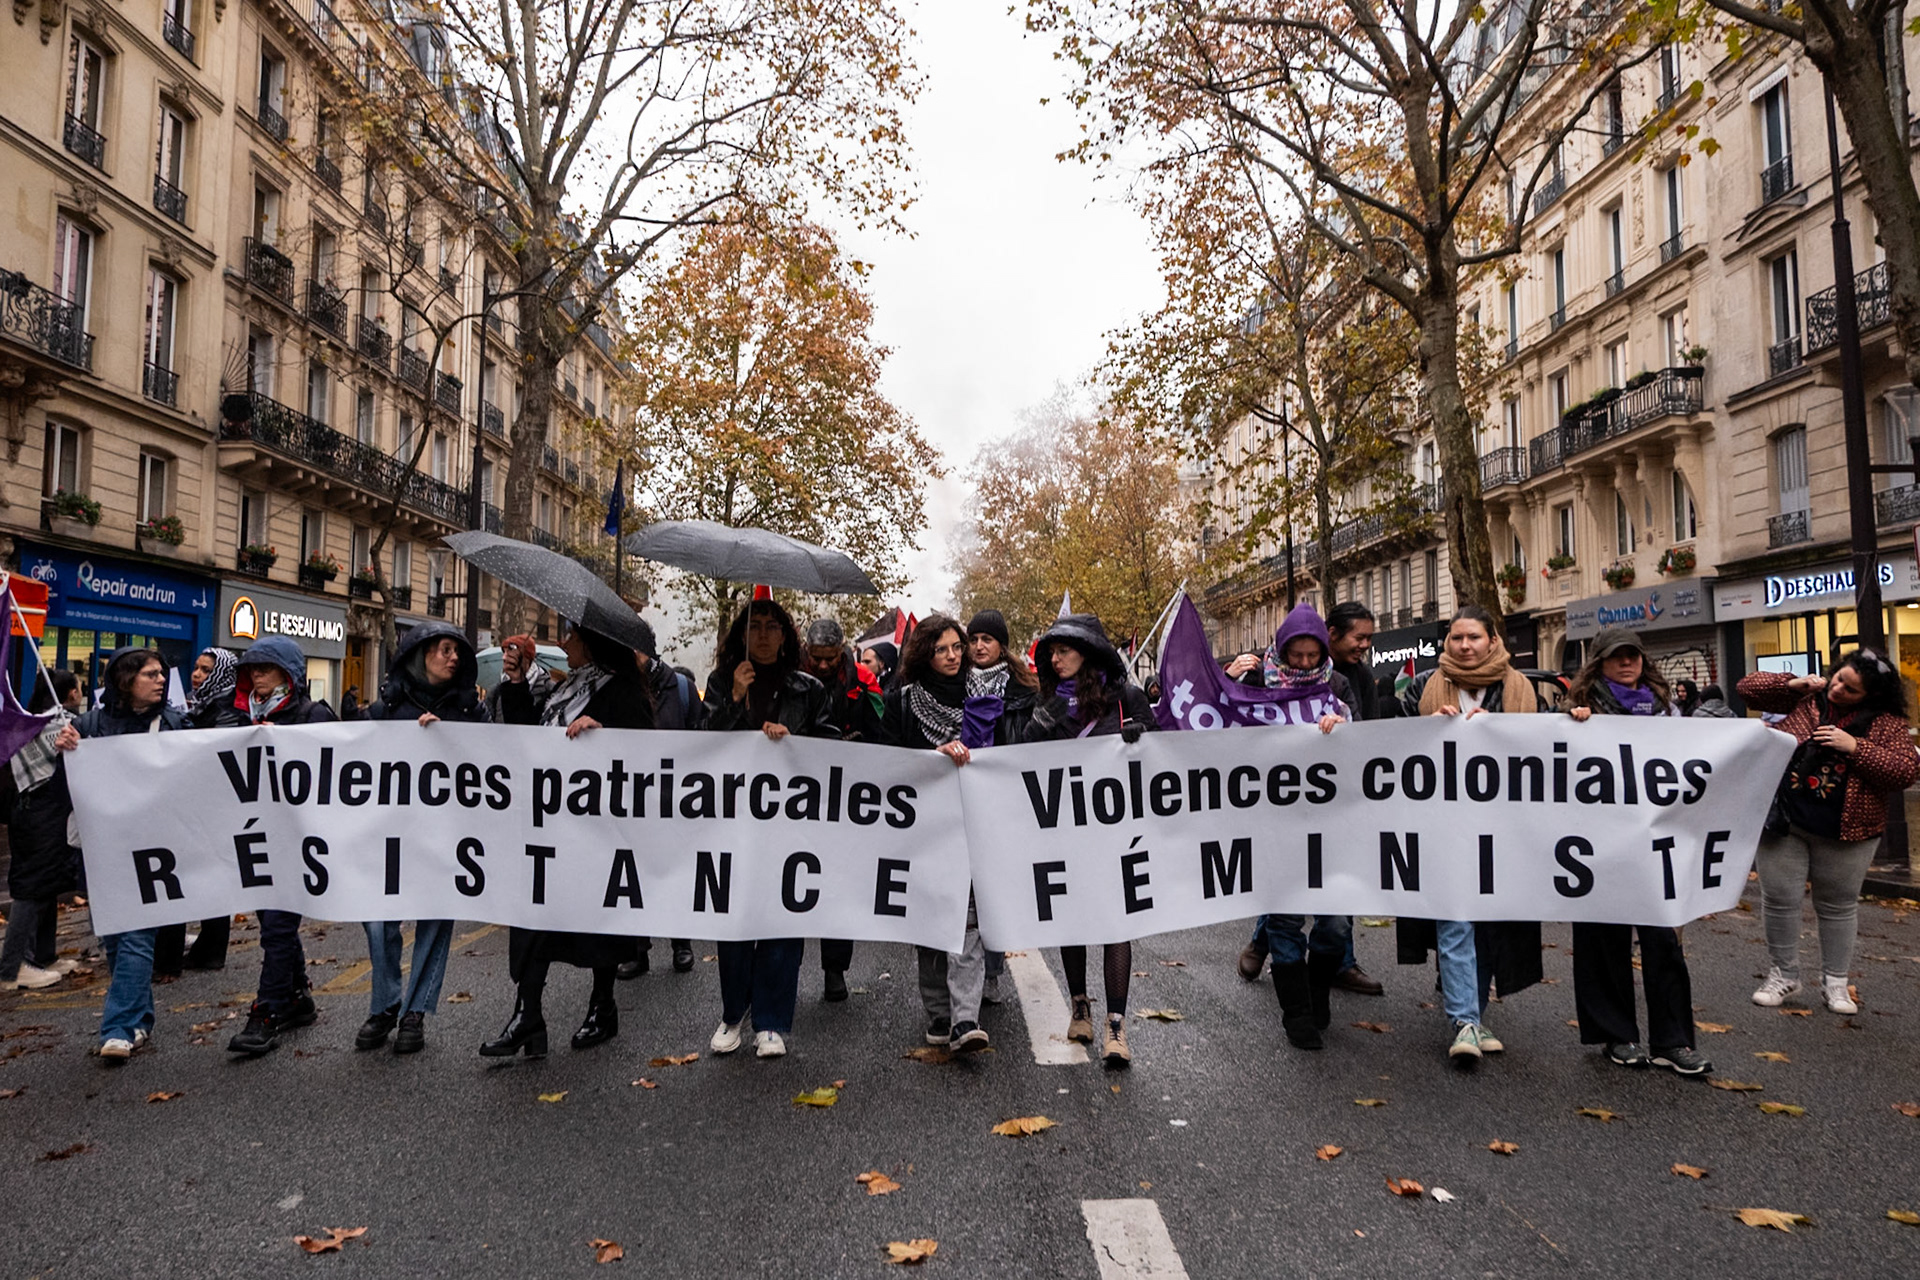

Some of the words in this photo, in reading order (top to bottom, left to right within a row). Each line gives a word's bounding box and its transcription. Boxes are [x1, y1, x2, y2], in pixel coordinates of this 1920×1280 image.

[77, 561, 128, 597] Repair
[129, 584, 155, 601] and
[156, 588, 176, 604] run
[1785, 564, 1893, 598] DESCHAUS
[264, 610, 278, 633] LE
[280, 612, 317, 638] RESEAU
[318, 619, 344, 642] IMMO
[218, 746, 511, 810] Violences
[532, 758, 918, 829] patriarcales
[1022, 761, 1338, 829] Violences
[1362, 741, 1712, 807] coloniales
[132, 818, 911, 918] RÉSISTANCE
[1033, 831, 1731, 921] FÉMINISTE
